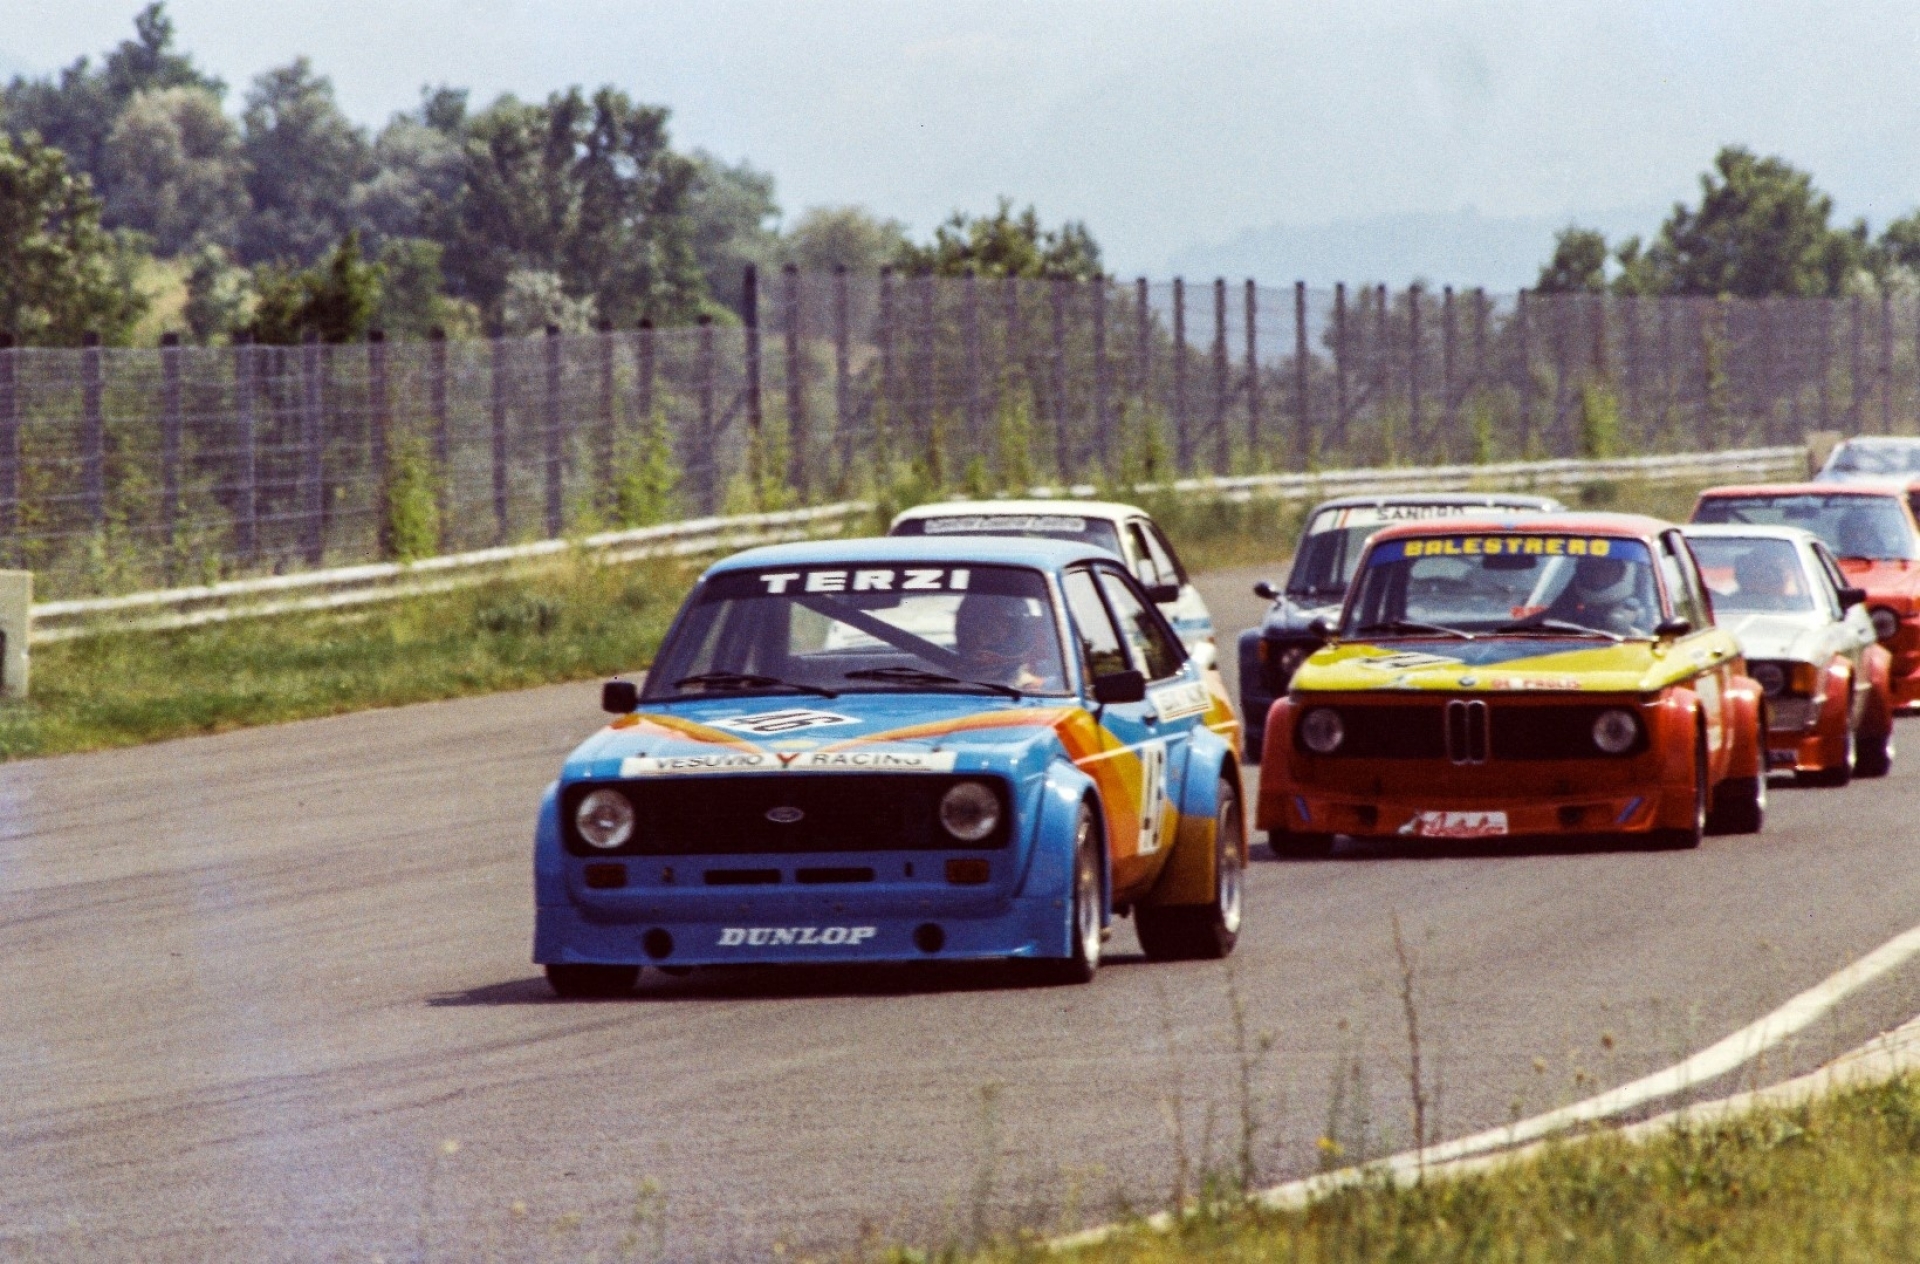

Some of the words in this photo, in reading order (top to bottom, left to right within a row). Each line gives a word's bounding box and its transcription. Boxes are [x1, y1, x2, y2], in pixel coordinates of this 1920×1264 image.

[1404, 537, 1610, 557] BALESTRERO
[760, 569, 970, 594] TERZI
[655, 753, 764, 769] VESUVIO
[811, 752, 923, 767] RACING
[716, 926, 877, 946] DUNLOP
